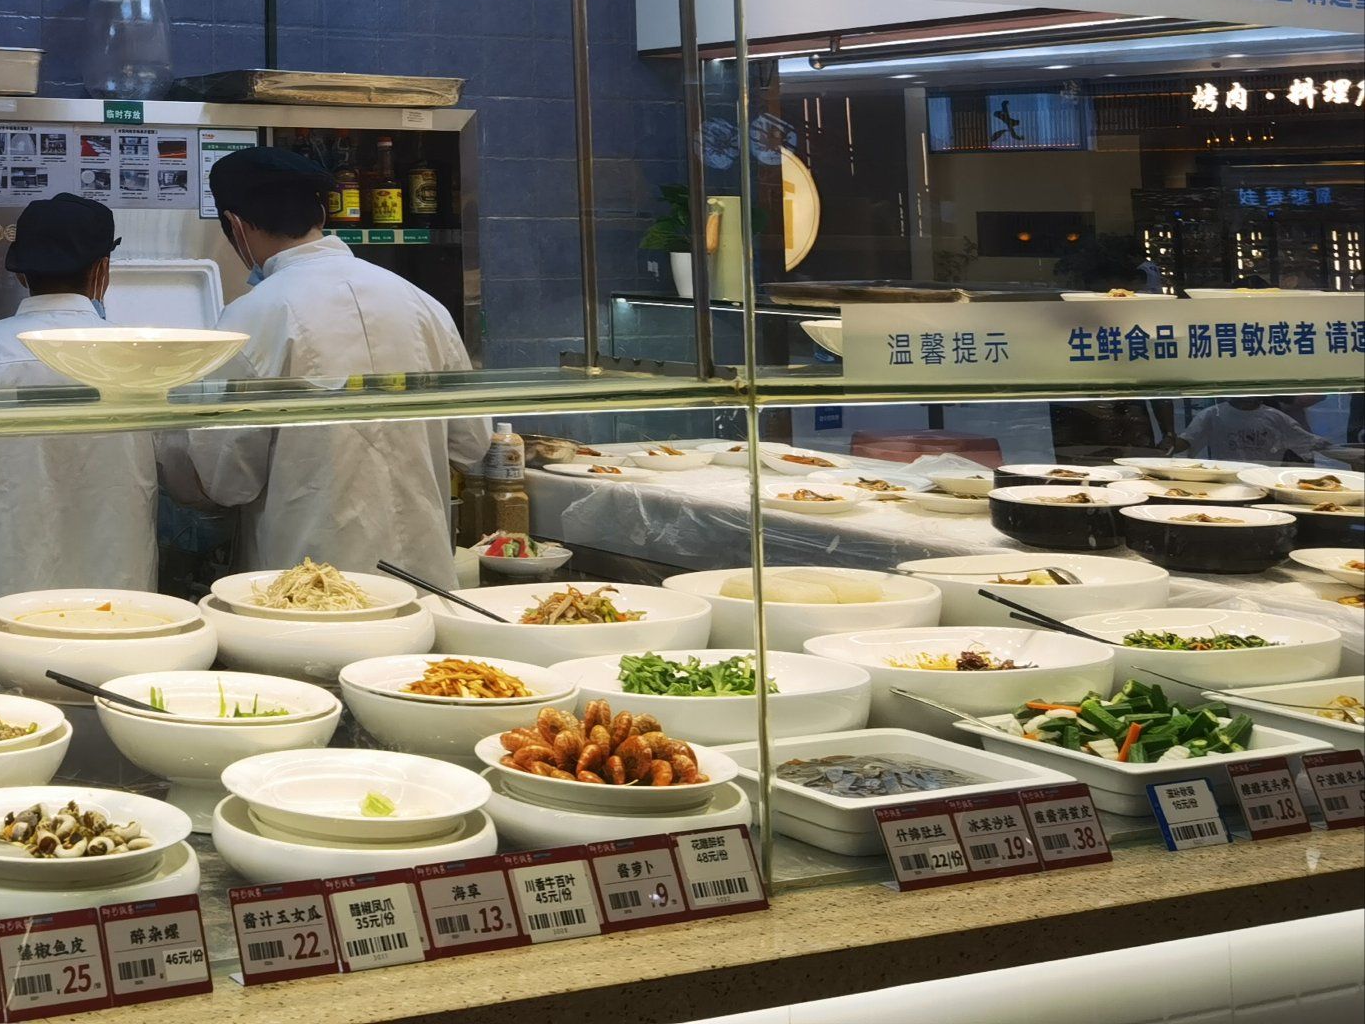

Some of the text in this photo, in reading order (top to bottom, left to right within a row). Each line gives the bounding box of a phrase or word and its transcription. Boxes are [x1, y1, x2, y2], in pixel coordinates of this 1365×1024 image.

[106, 109, 141, 120] 临时存放
[887, 331, 1010, 365] 温馨提示
[1067, 323, 1178, 362] 生鲜食品
[1187, 321, 1318, 359] 肠胃敏感者
[1277, 798, 1295, 820] 18
[1004, 836, 1025, 860] 19
[1074, 826, 1096, 850] 38
[617, 859, 654, 878] 酱萝卜
[451, 883, 481, 901] 海草
[525, 873, 576, 893] 川香牛百叶
[535, 887, 572, 903] 45元/份
[243, 904, 323, 930] 酱汁玉女瓜
[355, 912, 395, 930] 35元/份
[479, 905, 504, 933] 13
[130, 923, 180, 945] 醉杂螺
[165, 948, 204, 965] 46元/份
[293, 931, 321, 960] 22
[62, 964, 92, 994] 25
